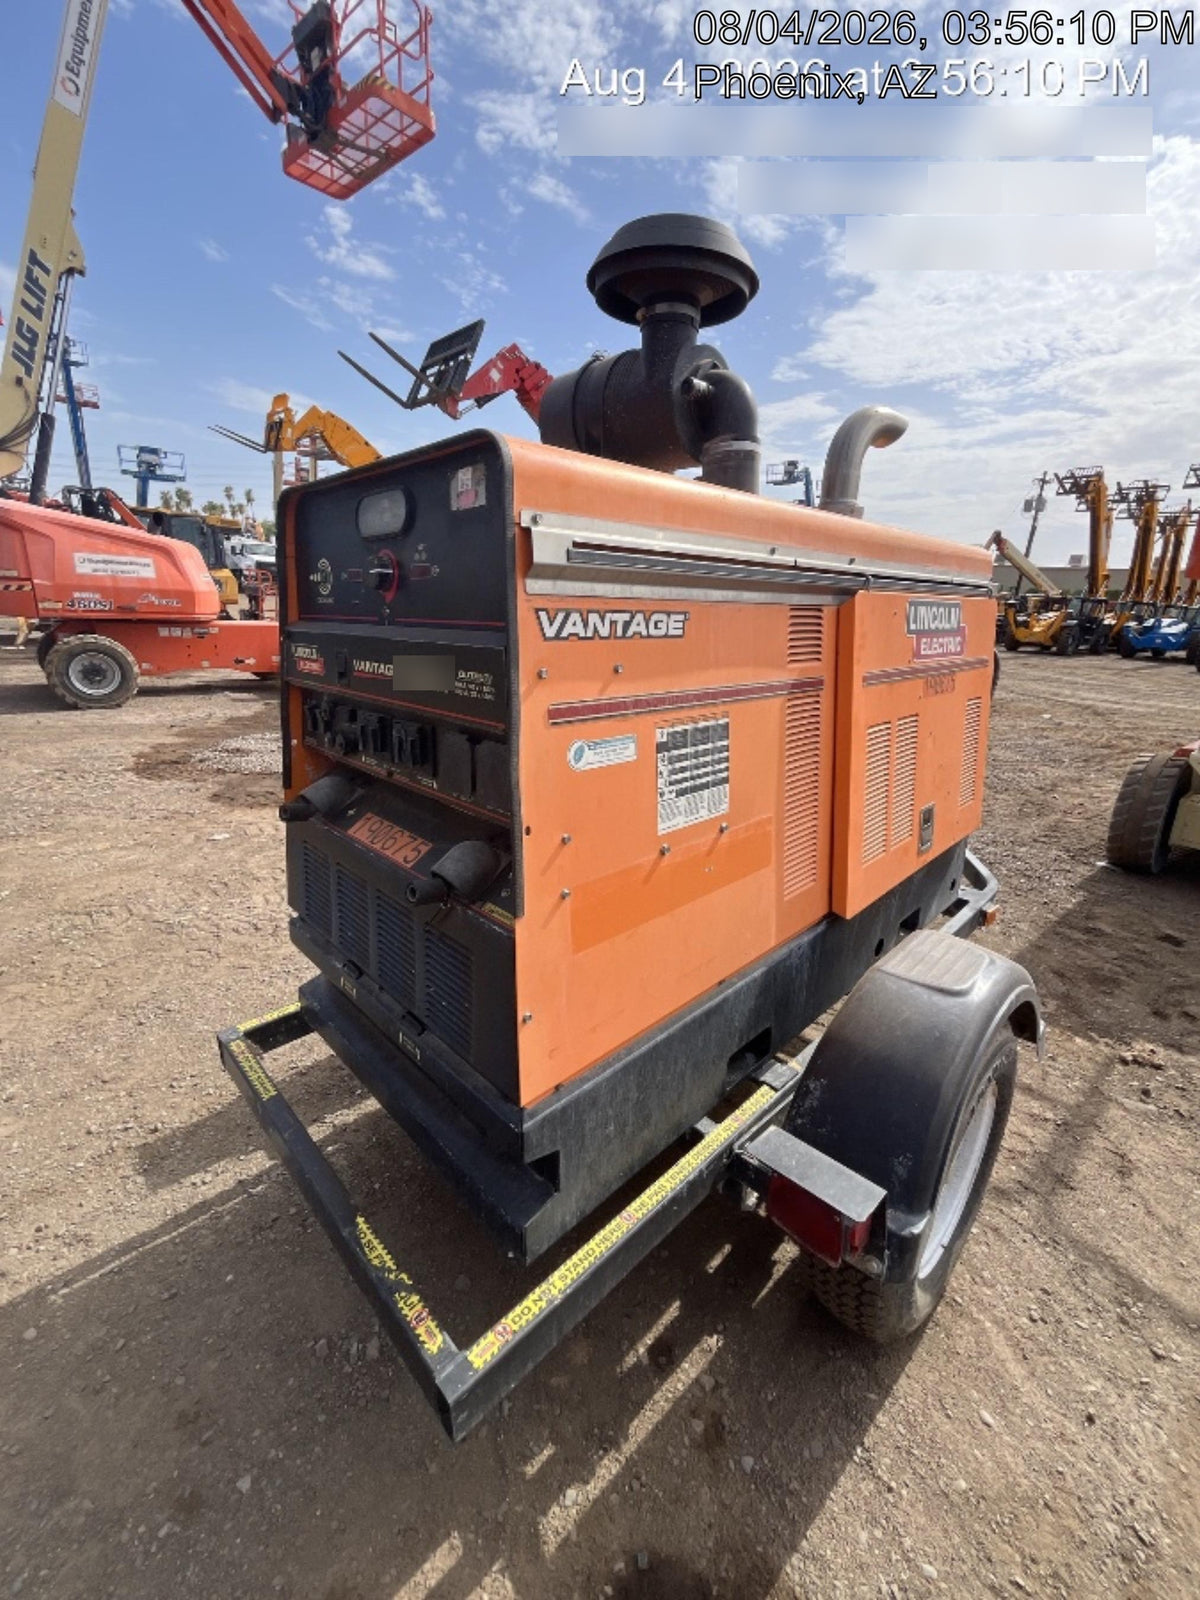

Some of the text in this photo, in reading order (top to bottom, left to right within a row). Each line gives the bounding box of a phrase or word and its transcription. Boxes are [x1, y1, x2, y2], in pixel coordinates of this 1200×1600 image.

[65, 0, 93, 78] Equipme
[11, 247, 52, 379] JLG LIFT
[536, 609, 687, 639] VANTAGE
[909, 605, 960, 630] LINCOLN
[920, 636, 962, 655] ELECTRIC
[352, 659, 394, 677] VANTAG
[510, 1305, 532, 1326] DO
[558, 1247, 597, 1282] STAND
